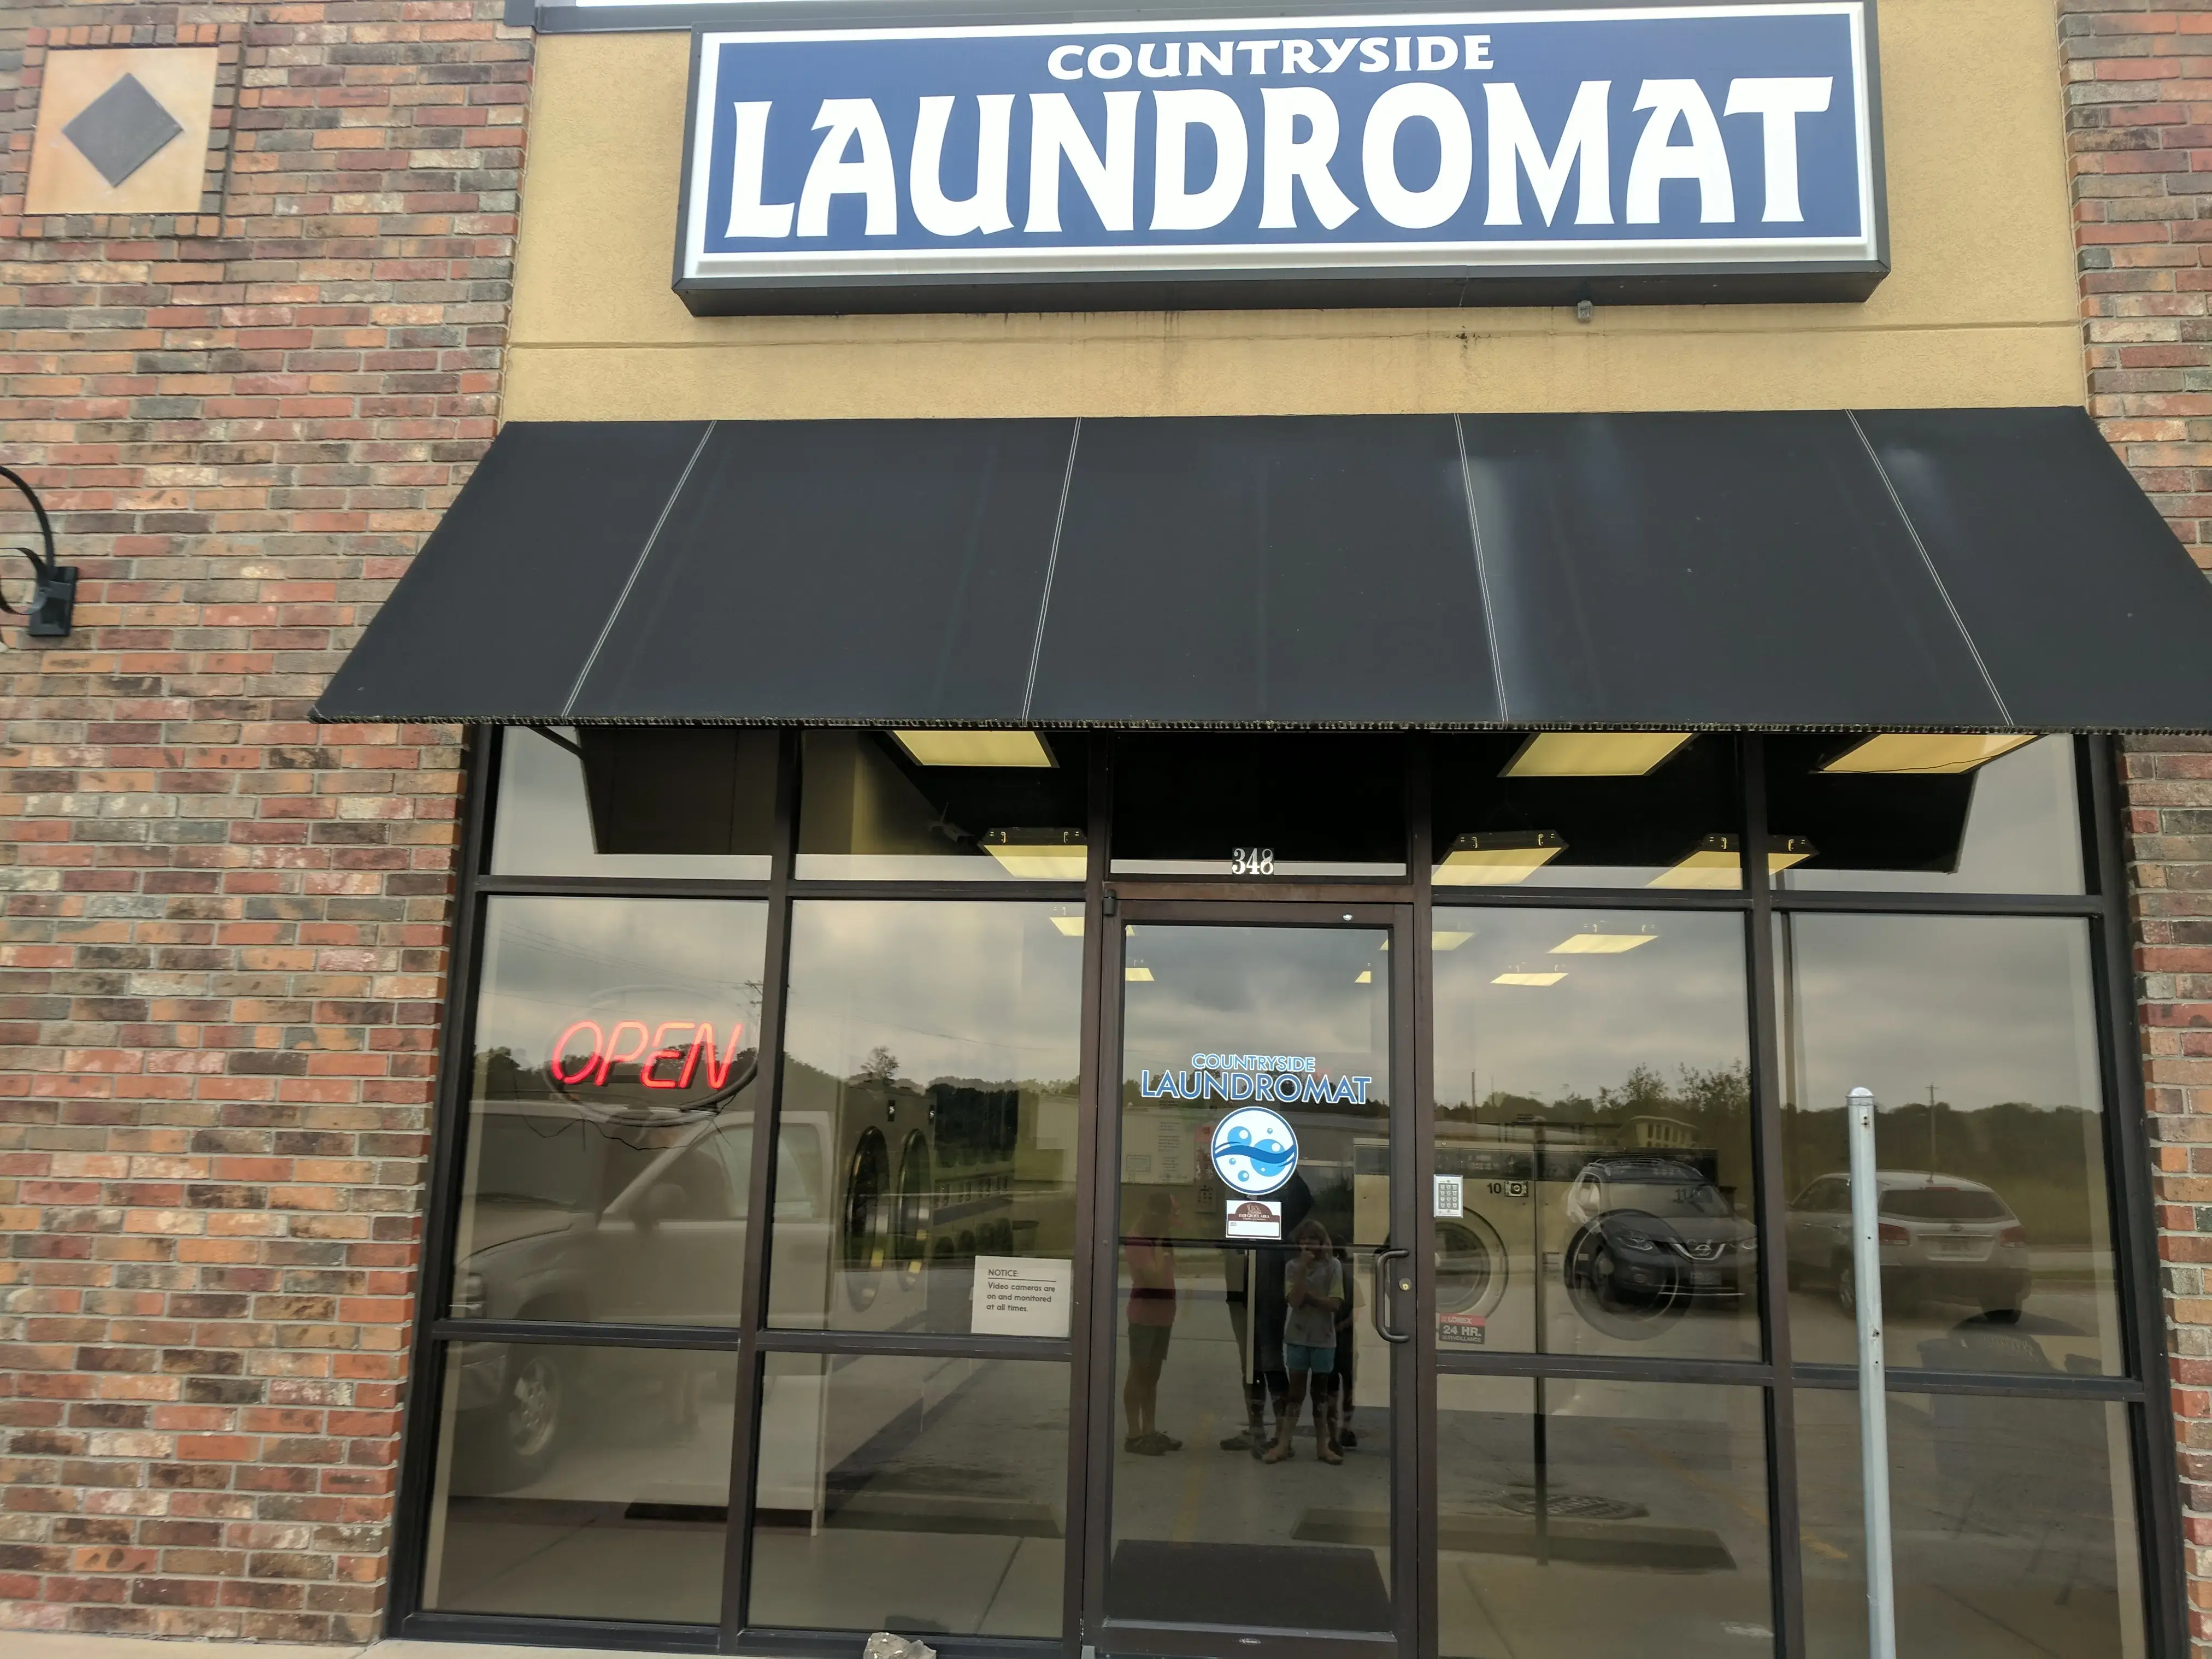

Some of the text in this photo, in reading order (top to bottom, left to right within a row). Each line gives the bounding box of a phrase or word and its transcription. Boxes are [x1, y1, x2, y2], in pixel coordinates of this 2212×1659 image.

[1047, 34, 1495, 81] COUNTRYSIDE
[724, 75, 1834, 240] LAUNDROMAT
[1232, 848, 1274, 875] 348
[551, 1020, 743, 1090] OPEN
[1191, 1052, 1316, 1073] COUNTRYSIDE
[1141, 1069, 1372, 1105] LAUNDROMAT
[1486, 1183, 1502, 1194] 10
[988, 1268, 1019, 1278] NOTICE:
[988, 1281, 1009, 1290] Video
[1442, 1334, 1481, 1343] SURVEILLANCE
[1443, 1325, 1481, 1337] 24 HR.
